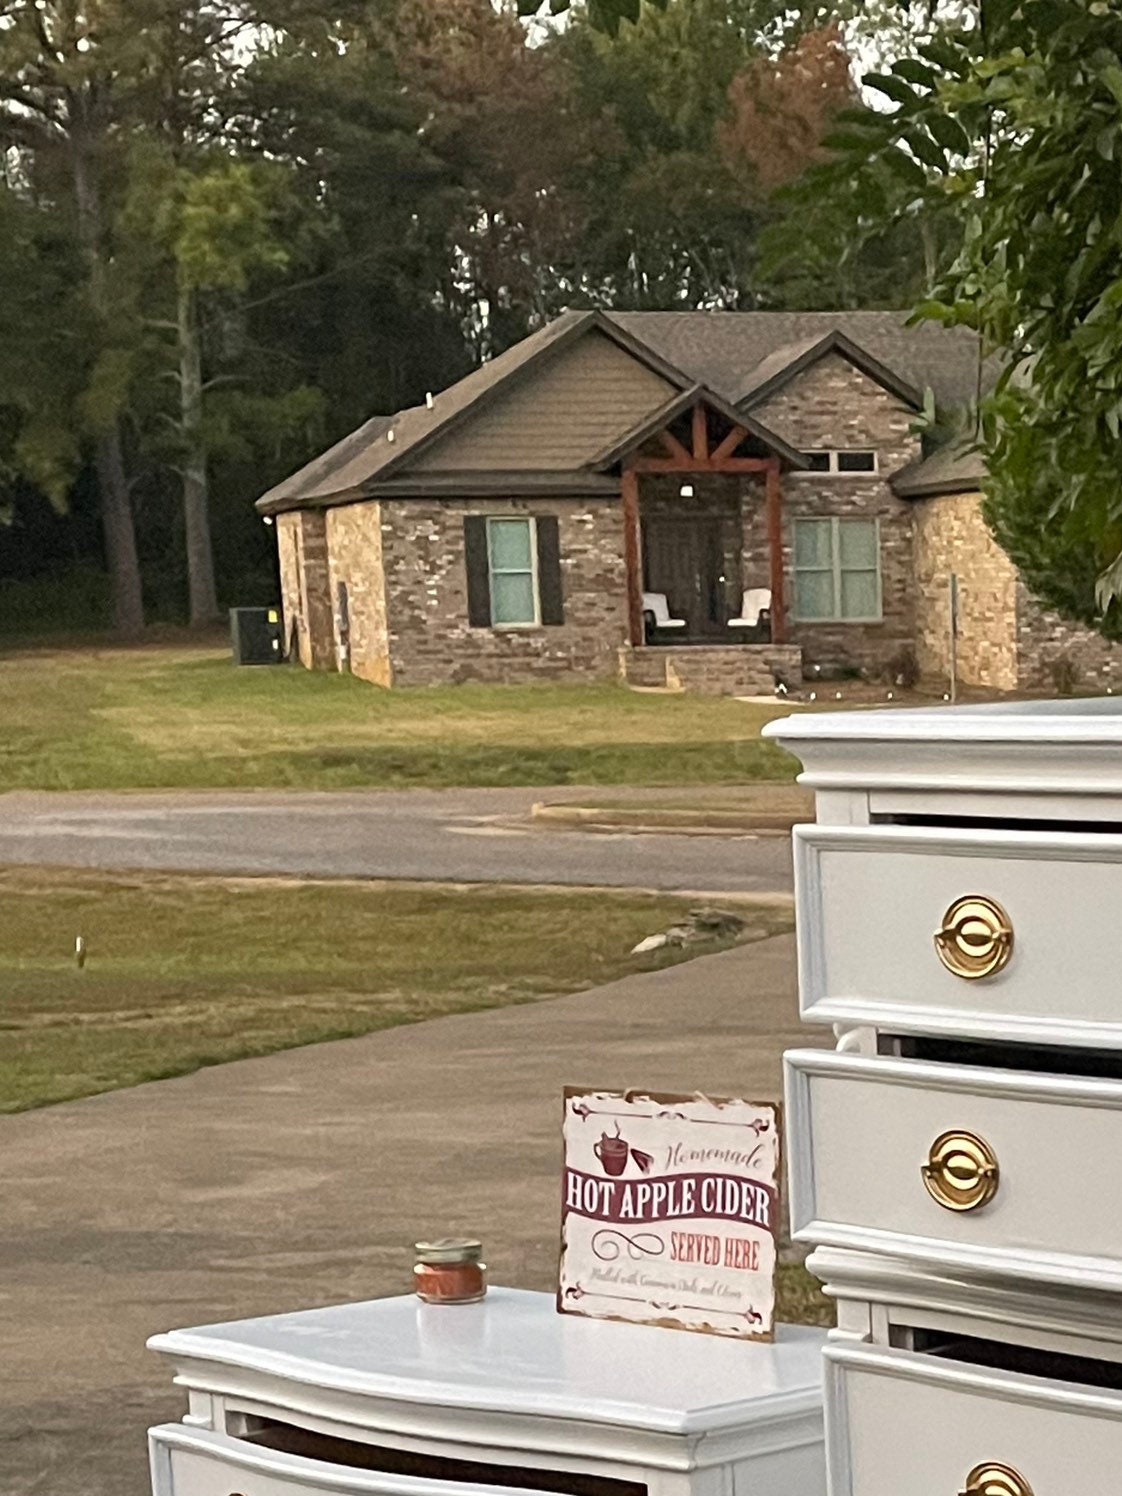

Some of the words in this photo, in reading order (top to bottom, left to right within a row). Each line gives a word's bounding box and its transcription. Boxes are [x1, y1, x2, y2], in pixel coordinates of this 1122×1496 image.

[665, 1142, 765, 1170] Homemade
[566, 1172, 615, 1216] HOT
[619, 1178, 695, 1218] APPLE
[701, 1178, 770, 1225] CIDER
[670, 1231, 720, 1266] SERVED
[724, 1238, 760, 1271] HERE
